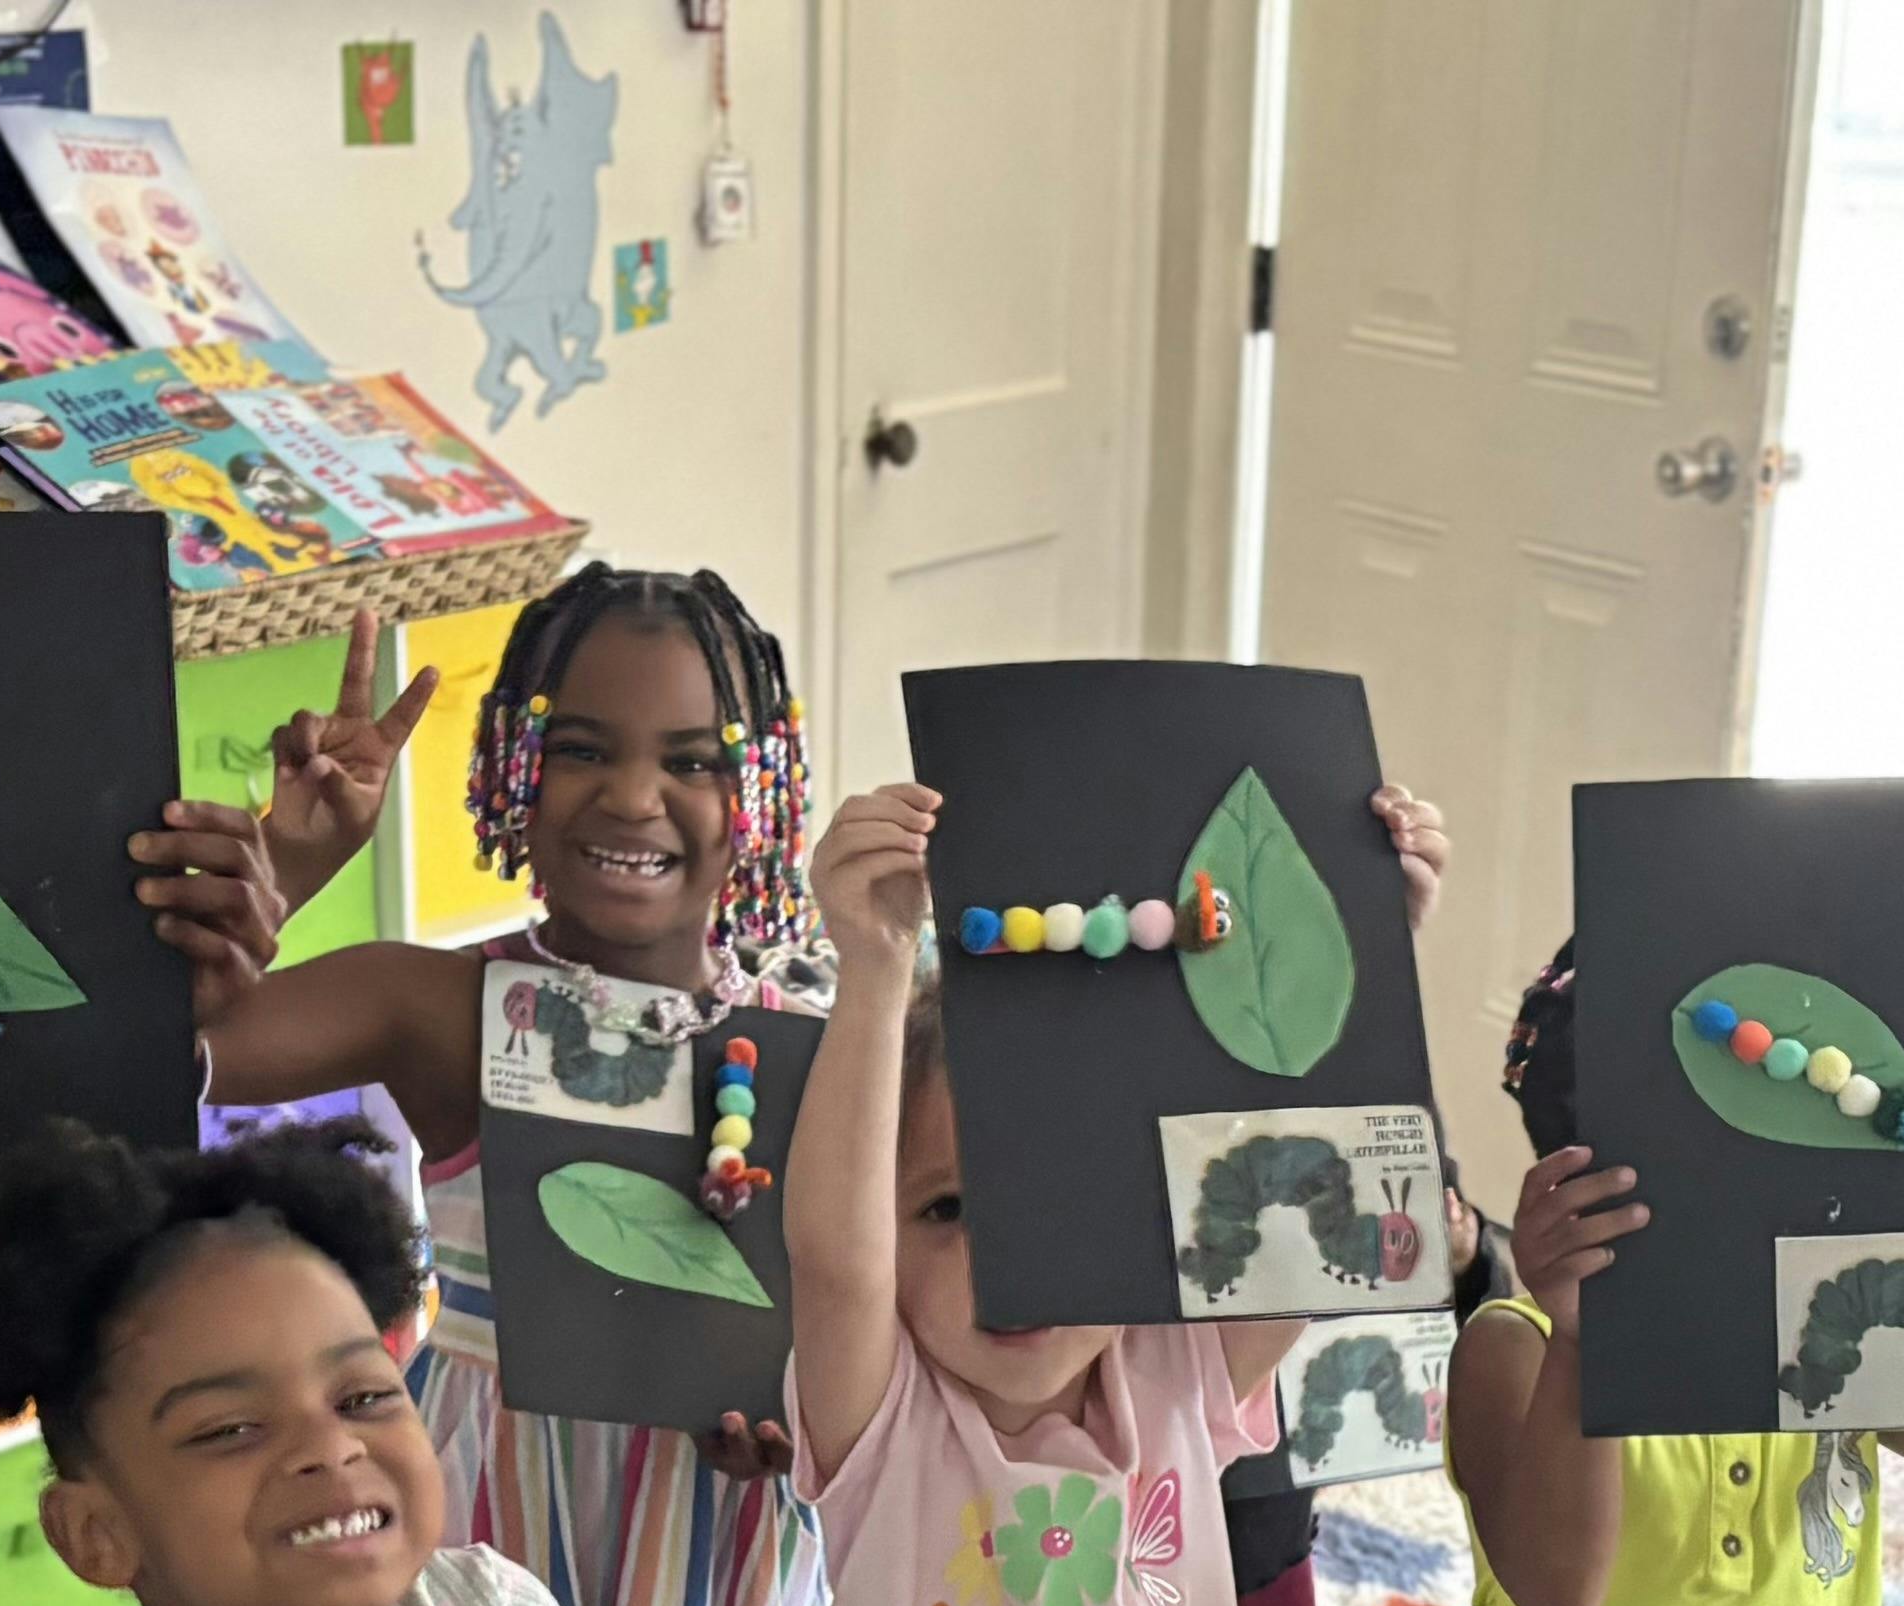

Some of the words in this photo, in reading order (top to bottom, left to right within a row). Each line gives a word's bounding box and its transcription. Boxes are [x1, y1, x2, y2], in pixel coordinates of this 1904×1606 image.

[66, 403, 171, 444] HOME
[267, 397, 359, 477] Library
[310, 464, 405, 533] Lola
